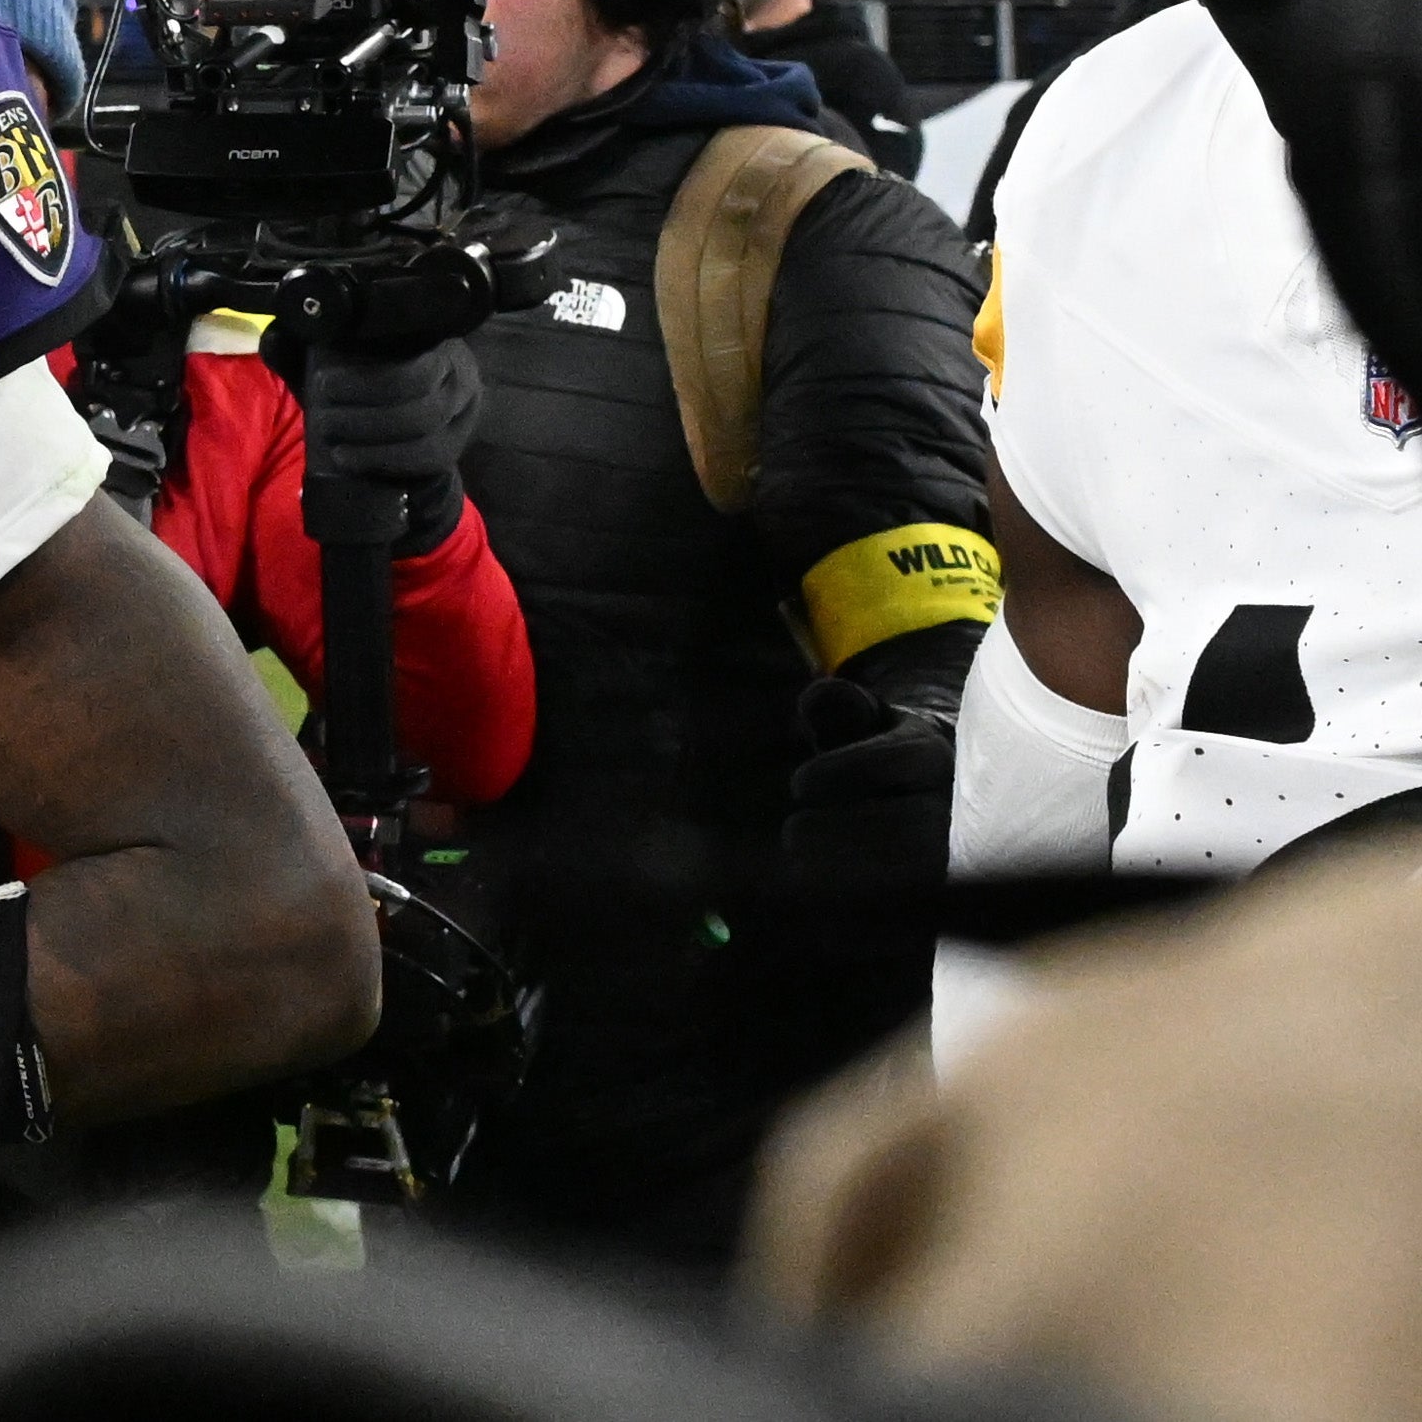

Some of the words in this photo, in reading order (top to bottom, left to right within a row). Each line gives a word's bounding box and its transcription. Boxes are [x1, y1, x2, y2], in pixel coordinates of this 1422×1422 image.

[228, 149, 280, 161] ncam
[570, 278, 601, 297] THE
[888, 543, 972, 576] WILD
